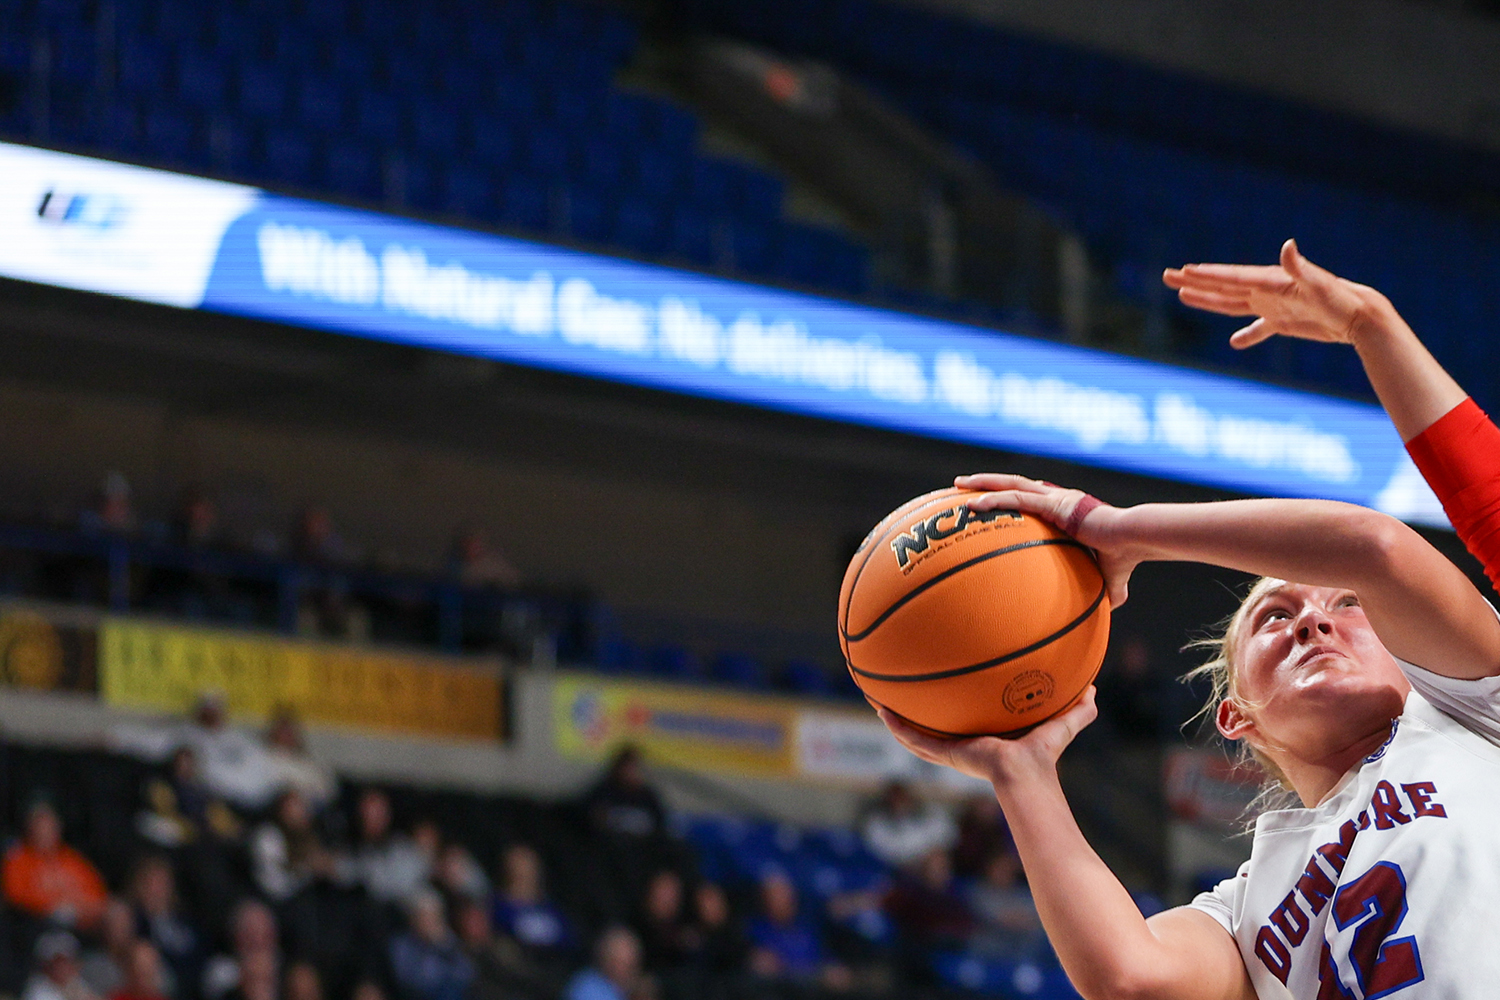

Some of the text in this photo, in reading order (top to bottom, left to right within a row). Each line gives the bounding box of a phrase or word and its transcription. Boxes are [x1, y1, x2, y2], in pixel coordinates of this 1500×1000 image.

[257, 220, 380, 306] With
[382, 242, 556, 337] Natural
[903, 541, 953, 576] OFFICIAL
[954, 525, 990, 543] GAME
